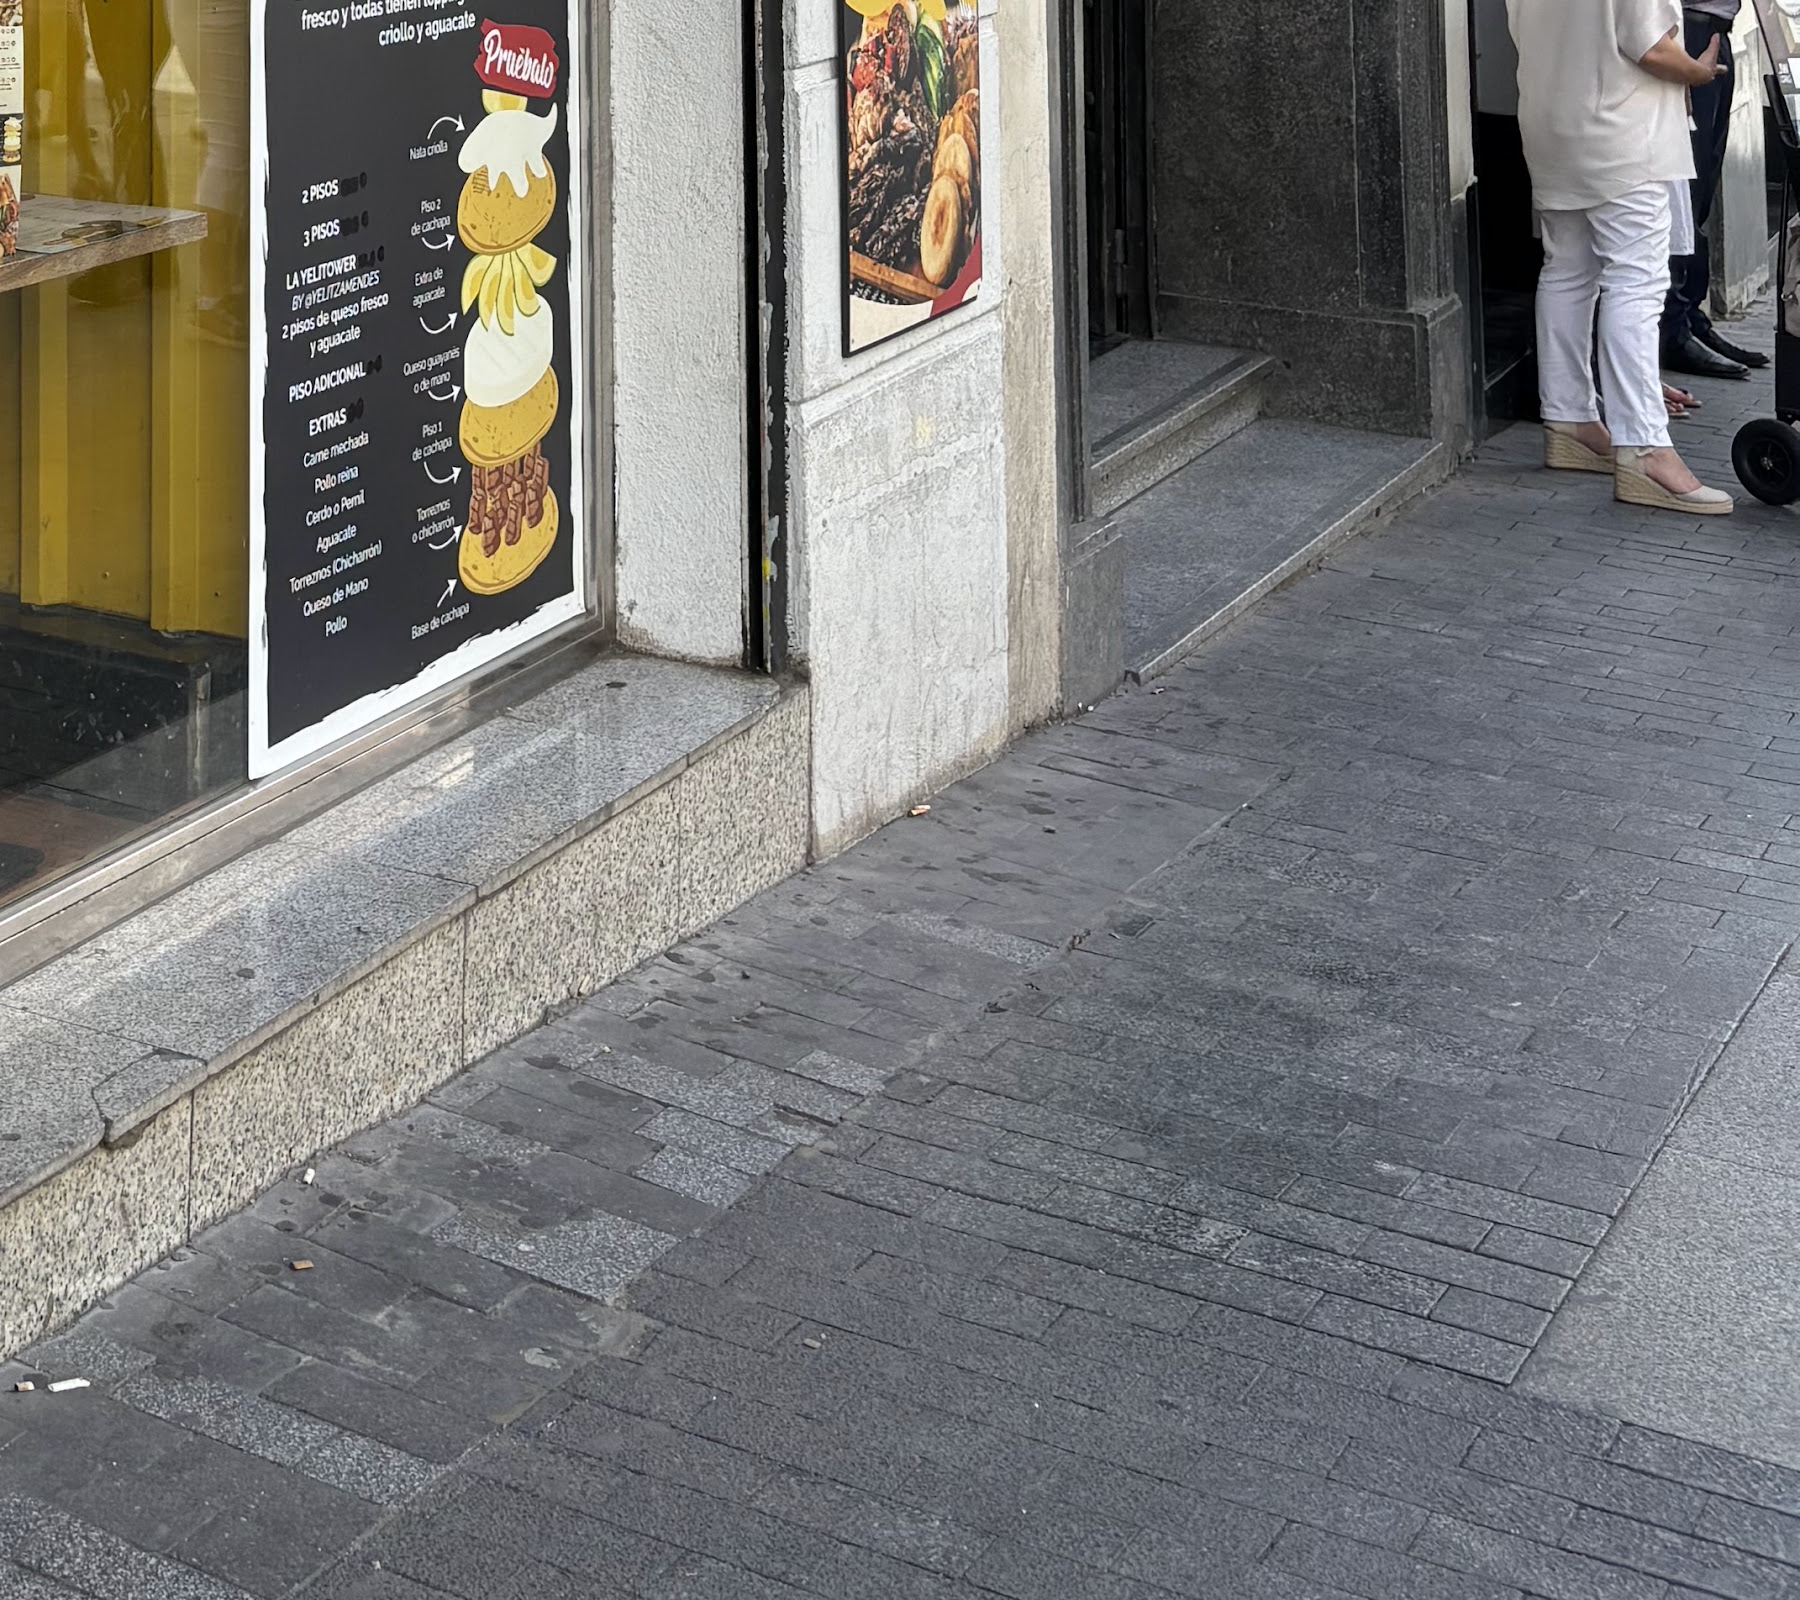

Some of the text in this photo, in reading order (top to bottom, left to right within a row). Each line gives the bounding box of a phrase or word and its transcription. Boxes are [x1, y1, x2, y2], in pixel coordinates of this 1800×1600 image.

[301, 7, 339, 30] fresco
[341, 6, 349, 28] y
[378, 11, 476, 46] criollo y aguacate
[409, 140, 448, 161] Nata criolla
[302, 179, 339, 204] 2 PISOS
[420, 198, 441, 214] Piso 2
[303, 219, 340, 247] 3 PISOS
[410, 214, 451, 236] de cachapa
[286, 254, 357, 290] LA YELITOWER
[414, 267, 443, 287] Extra de
[291, 270, 380, 311] BY @YELITZAMENDES
[412, 285, 446, 309] aguacate
[281, 292, 390, 341] 2 pisos de queso fresco
[310, 324, 361, 358] y aguacate
[288, 361, 366, 402] PISO ADICIONAL
[403, 359, 426, 377] Queso
[420, 378, 430, 392] de
[430, 372, 451, 388] mano
[309, 408, 347, 436] EXTRAS
[422, 423, 437, 438] Piso
[303, 431, 369, 468] Carne mechada
[411, 436, 452, 461] de cachapa
[314, 465, 359, 494] Pollo reina
[305, 489, 366, 527] Cerdo o Pernil
[416, 498, 451, 521] Torreznos
[316, 523, 357, 554] Aguacate
[418, 515, 455, 541] chicharrón
[289, 539, 383, 593] Torreznos (Chicharrón)
[303, 577, 369, 618] Queso de Mano
[325, 615, 348, 638] Pollo
[411, 601, 470, 640] Base de cachapa
